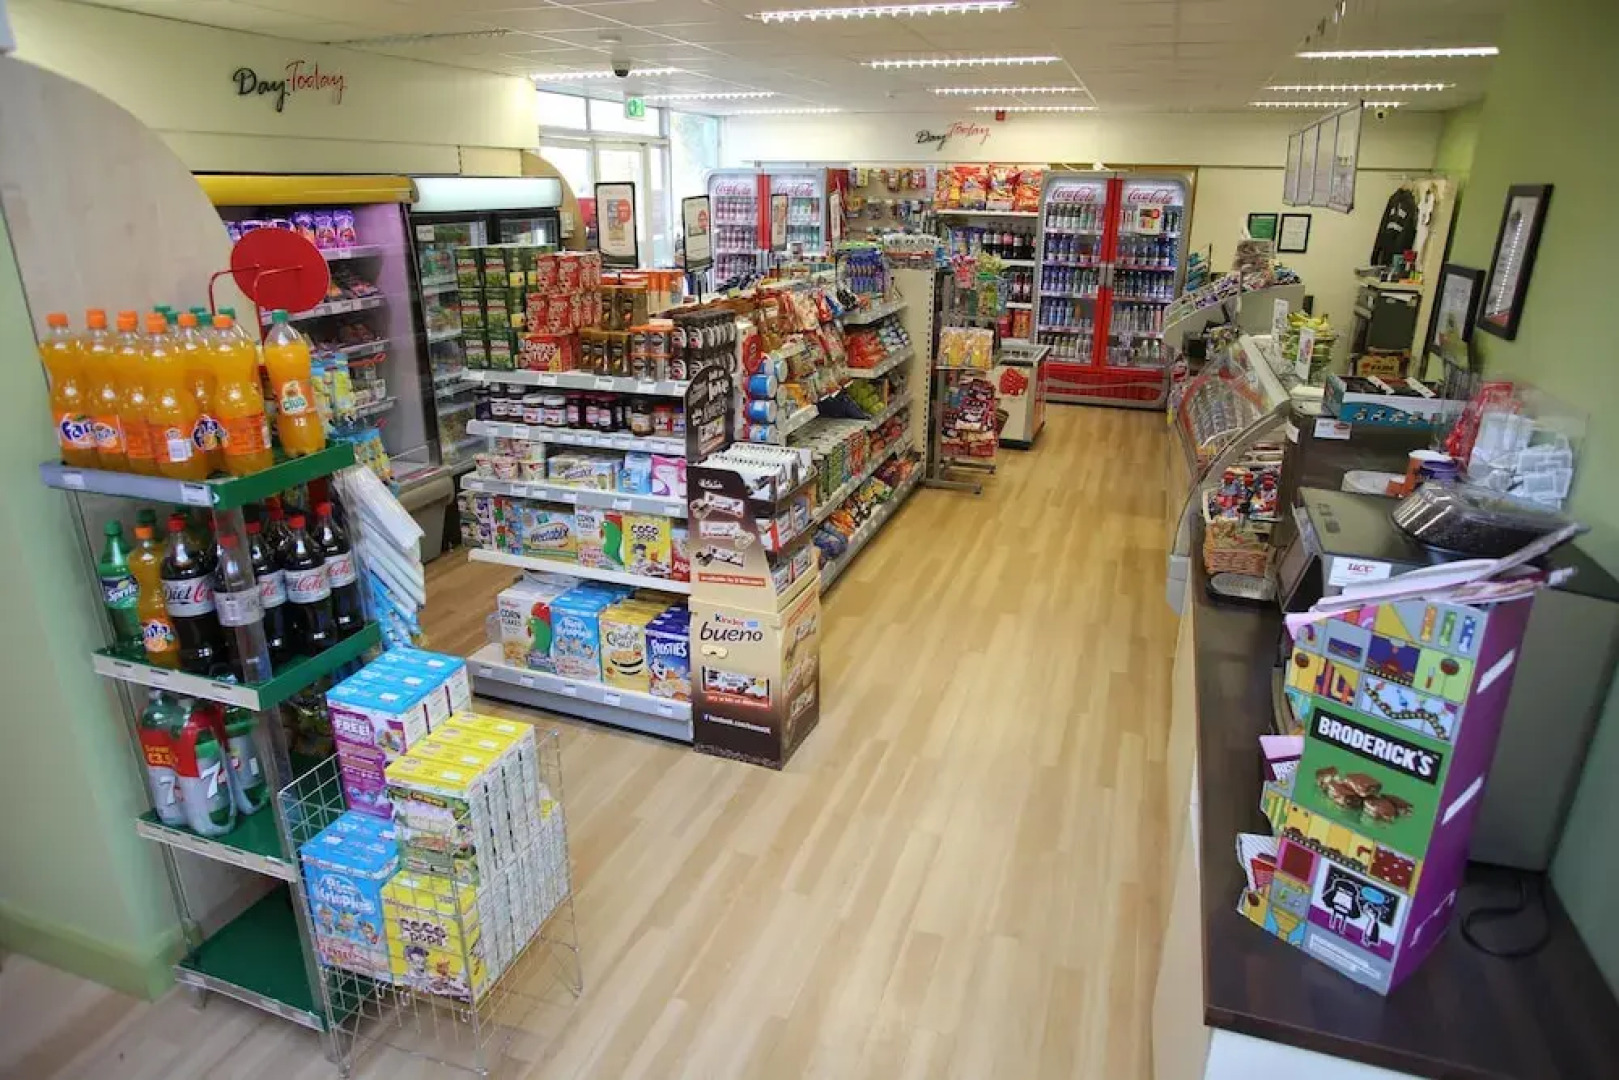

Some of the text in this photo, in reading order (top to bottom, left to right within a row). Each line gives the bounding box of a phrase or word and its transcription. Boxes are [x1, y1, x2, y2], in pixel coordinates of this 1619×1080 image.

[1052, 187, 1097, 202] Coca-Cola
[1128, 189, 1174, 203] Coca-Cola
[700, 621, 763, 642] bueno
[1318, 716, 1434, 776] BRODERICK'S
